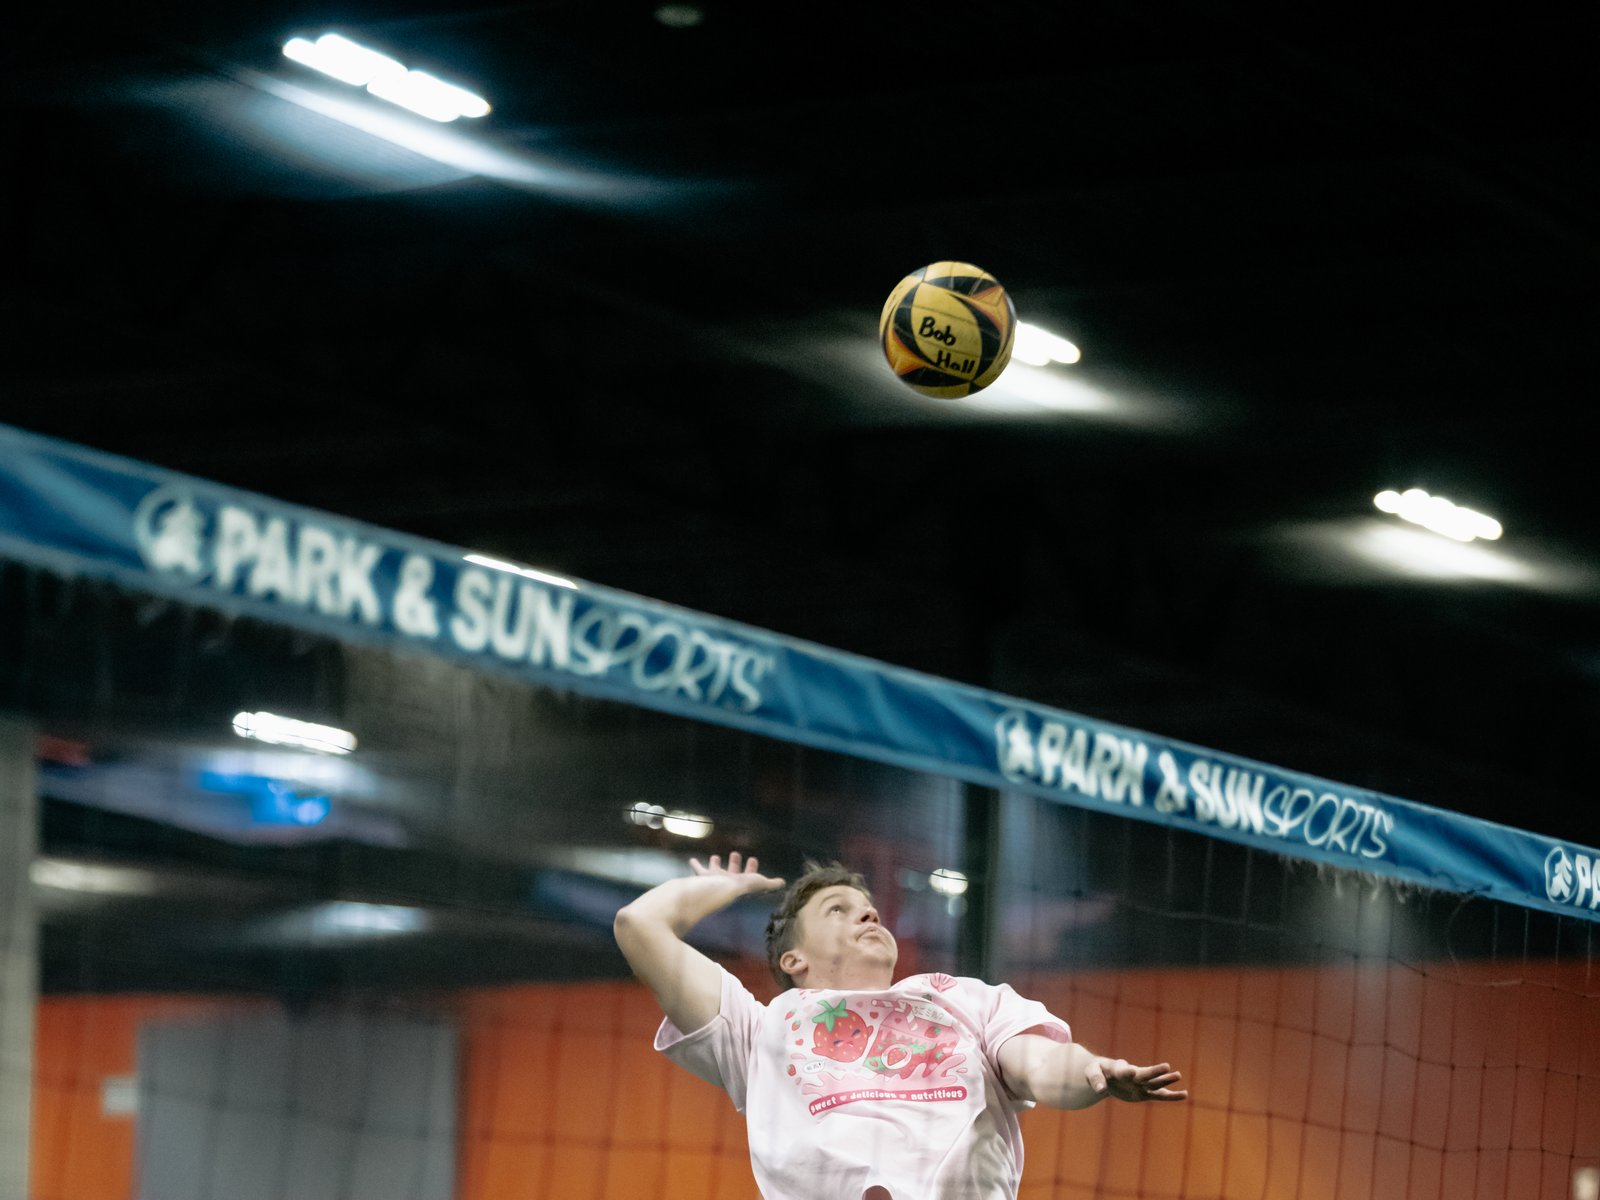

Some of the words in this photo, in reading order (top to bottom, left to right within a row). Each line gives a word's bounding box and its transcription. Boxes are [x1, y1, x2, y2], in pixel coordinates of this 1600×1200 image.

[919, 316, 957, 346] Bob
[936, 350, 975, 374] Hall
[212, 505, 384, 626] PARK
[394, 552, 441, 640] &
[1036, 721, 1148, 806] PARK
[1154, 750, 1190, 813] &
[810, 1096, 837, 1114] sweet
[910, 1090, 963, 1100] nutritious
